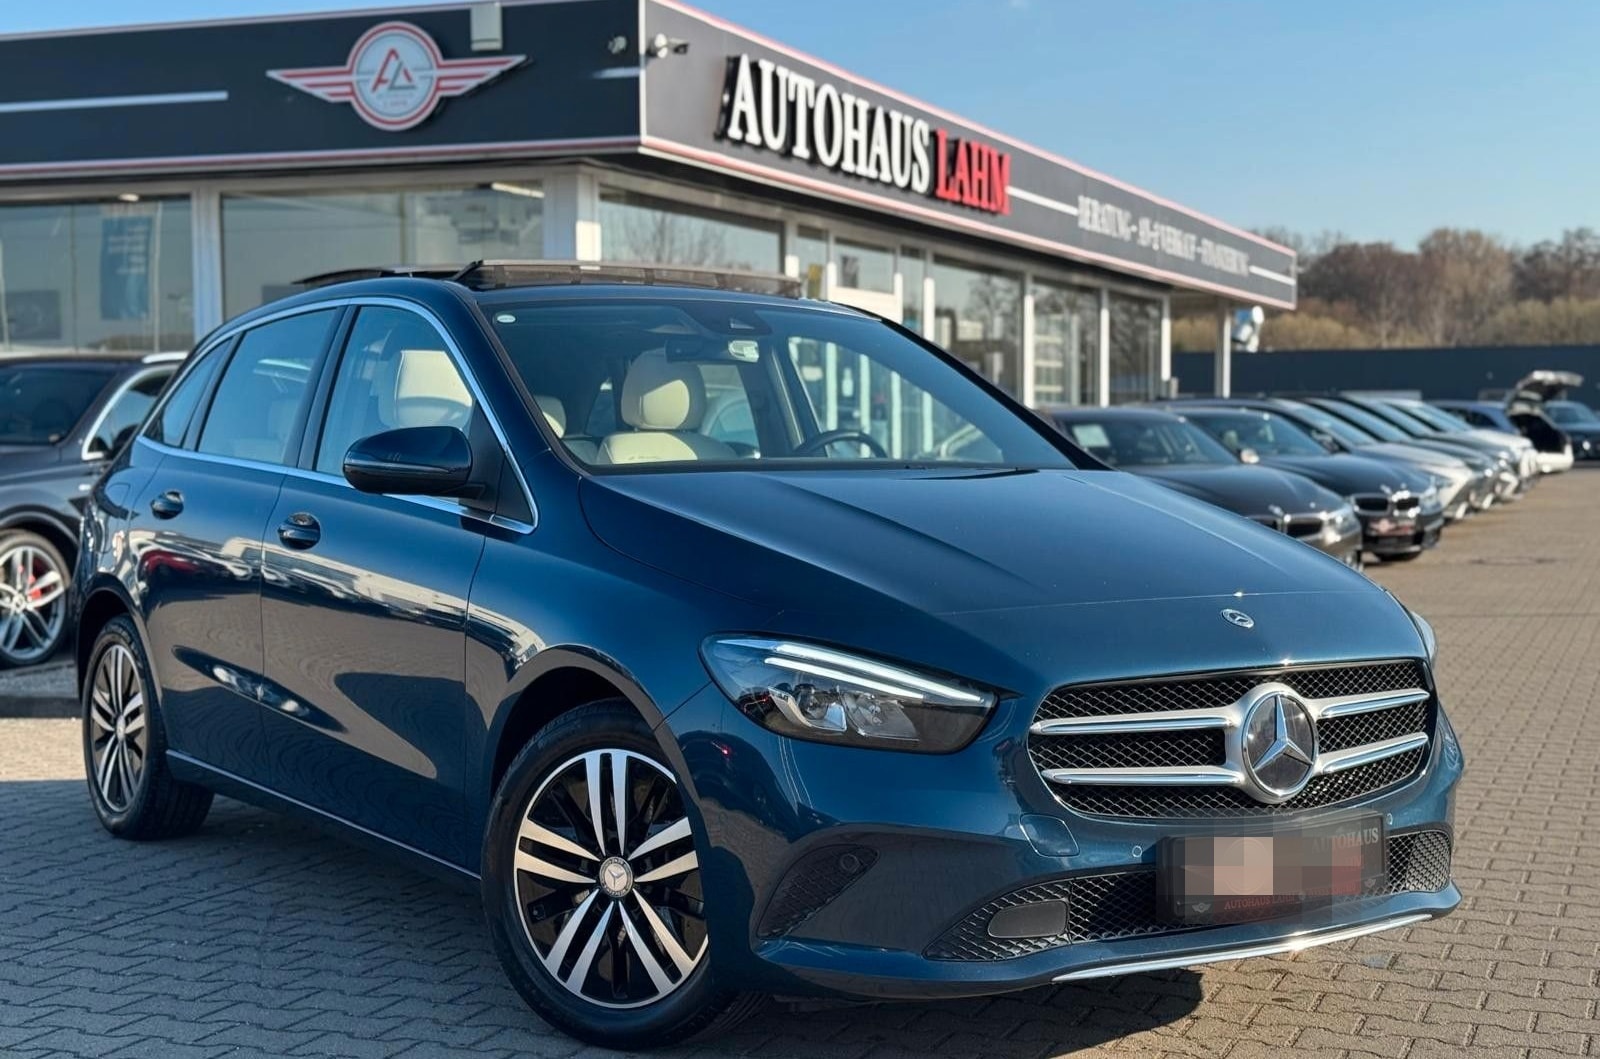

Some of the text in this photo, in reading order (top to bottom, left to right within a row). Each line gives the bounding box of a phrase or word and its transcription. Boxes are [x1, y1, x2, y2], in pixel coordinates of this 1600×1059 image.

[727, 53, 1011, 215] AUTOHAUS LAHM
[1311, 828, 1379, 854] AUTOHAUS
